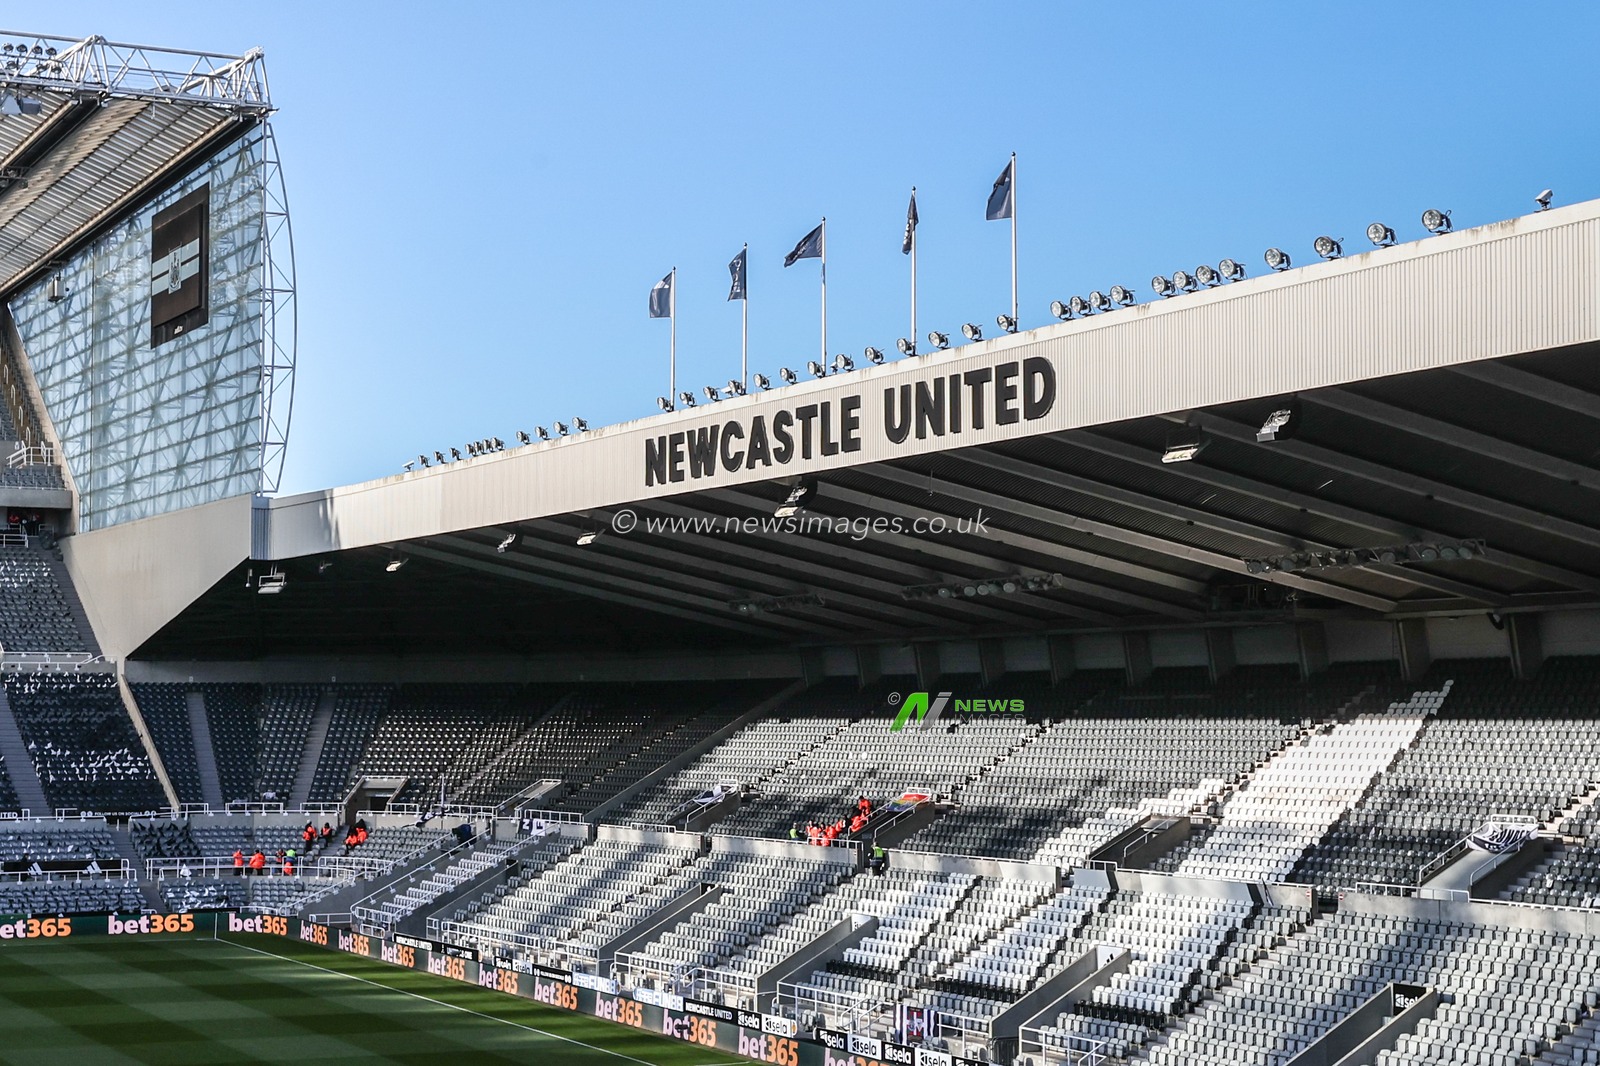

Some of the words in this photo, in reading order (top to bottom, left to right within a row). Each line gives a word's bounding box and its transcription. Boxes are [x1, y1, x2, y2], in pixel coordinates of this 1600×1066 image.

[645, 395, 861, 487] NEWCASTLE
[884, 356, 1057, 443] UNITED
[108, 914, 195, 935] bet365
[229, 913, 288, 936] bet365
[300, 920, 328, 945] bet365
[338, 929, 370, 956] bet365
[381, 940, 415, 968] bet365
[427, 951, 465, 981] bet365
[478, 963, 518, 995] bet365
[534, 977, 578, 1010] bet365
[595, 991, 643, 1027] bet365
[685, 1001, 714, 1017] NEWCASTLE
[714, 1009, 733, 1020] UNITED
[744, 1013, 760, 1029] sela
[663, 1008, 717, 1047] bet365
[771, 1019, 788, 1034] sela
[738, 1026, 799, 1066] bet365
[827, 1035, 844, 1049] sela
[859, 1042, 877, 1056] sela
[892, 1047, 912, 1064] sela
